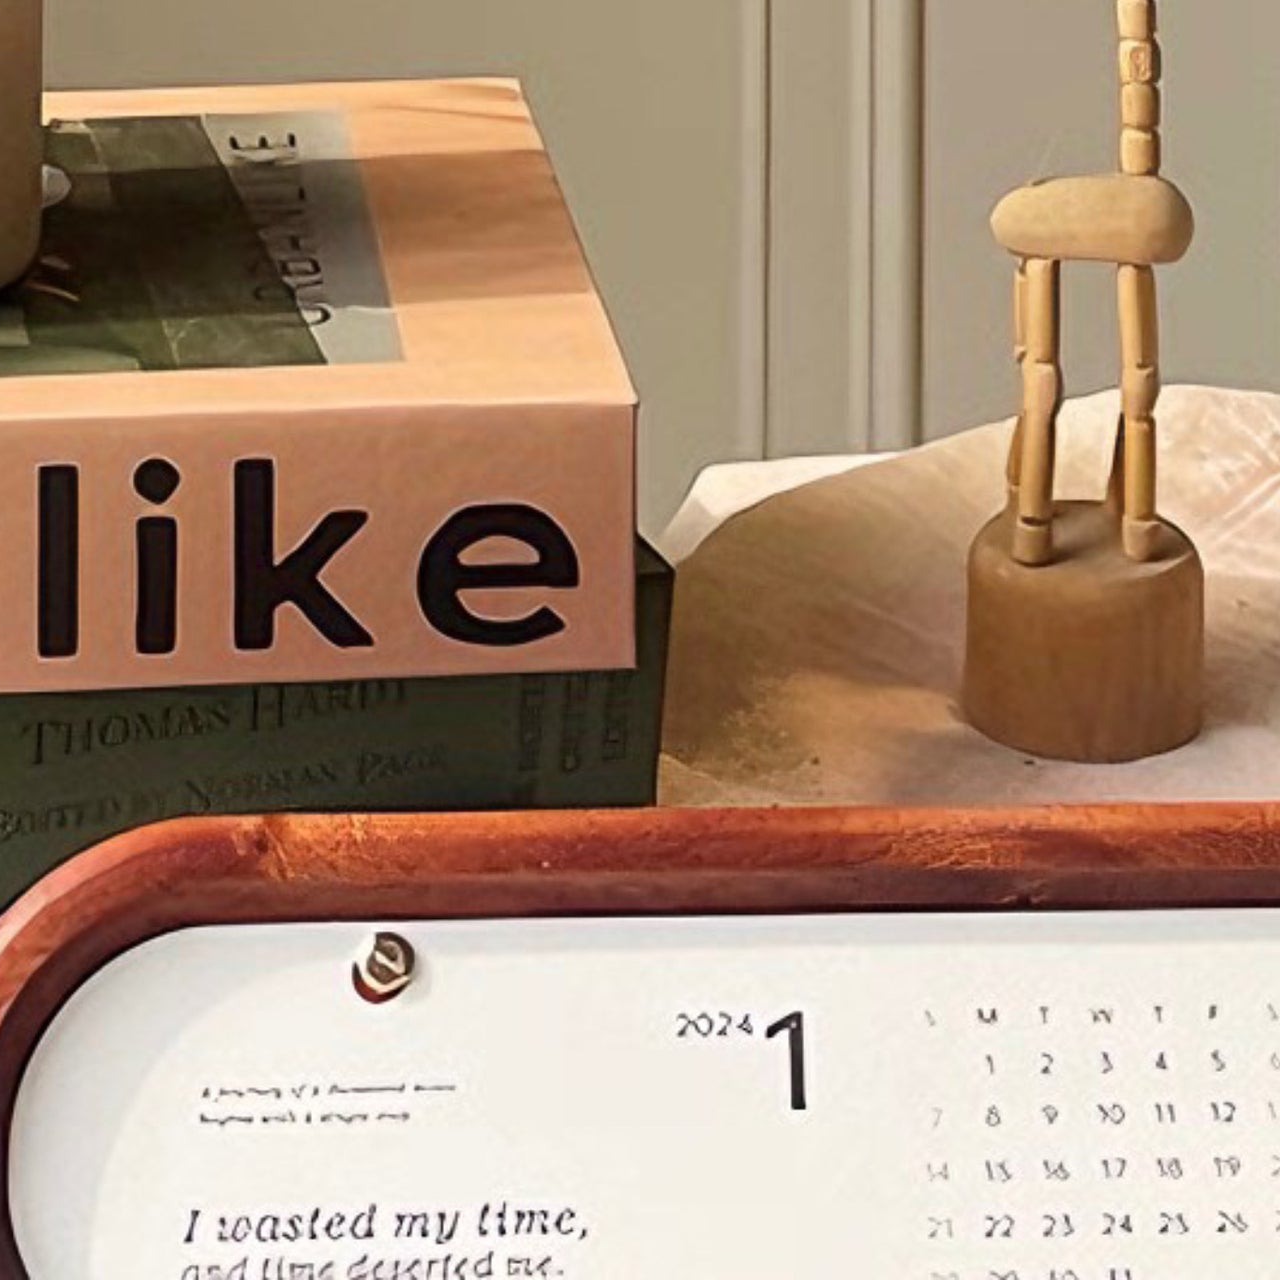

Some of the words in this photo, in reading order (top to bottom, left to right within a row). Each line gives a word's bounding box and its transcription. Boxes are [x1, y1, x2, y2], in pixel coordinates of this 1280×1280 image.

[676, 1011, 754, 1038] 2024
[765, 1010, 806, 1110] 1
[1040, 1051, 1055, 1075] 2
[985, 1104, 1002, 1128] 8
[1154, 1102, 1177, 1124] 11
[1210, 1100, 1237, 1123] 12
[183, 1209, 201, 1244] I
[217, 1203, 378, 1243] wasted
[394, 1209, 461, 1245] my
[477, 1201, 589, 1241] time,
